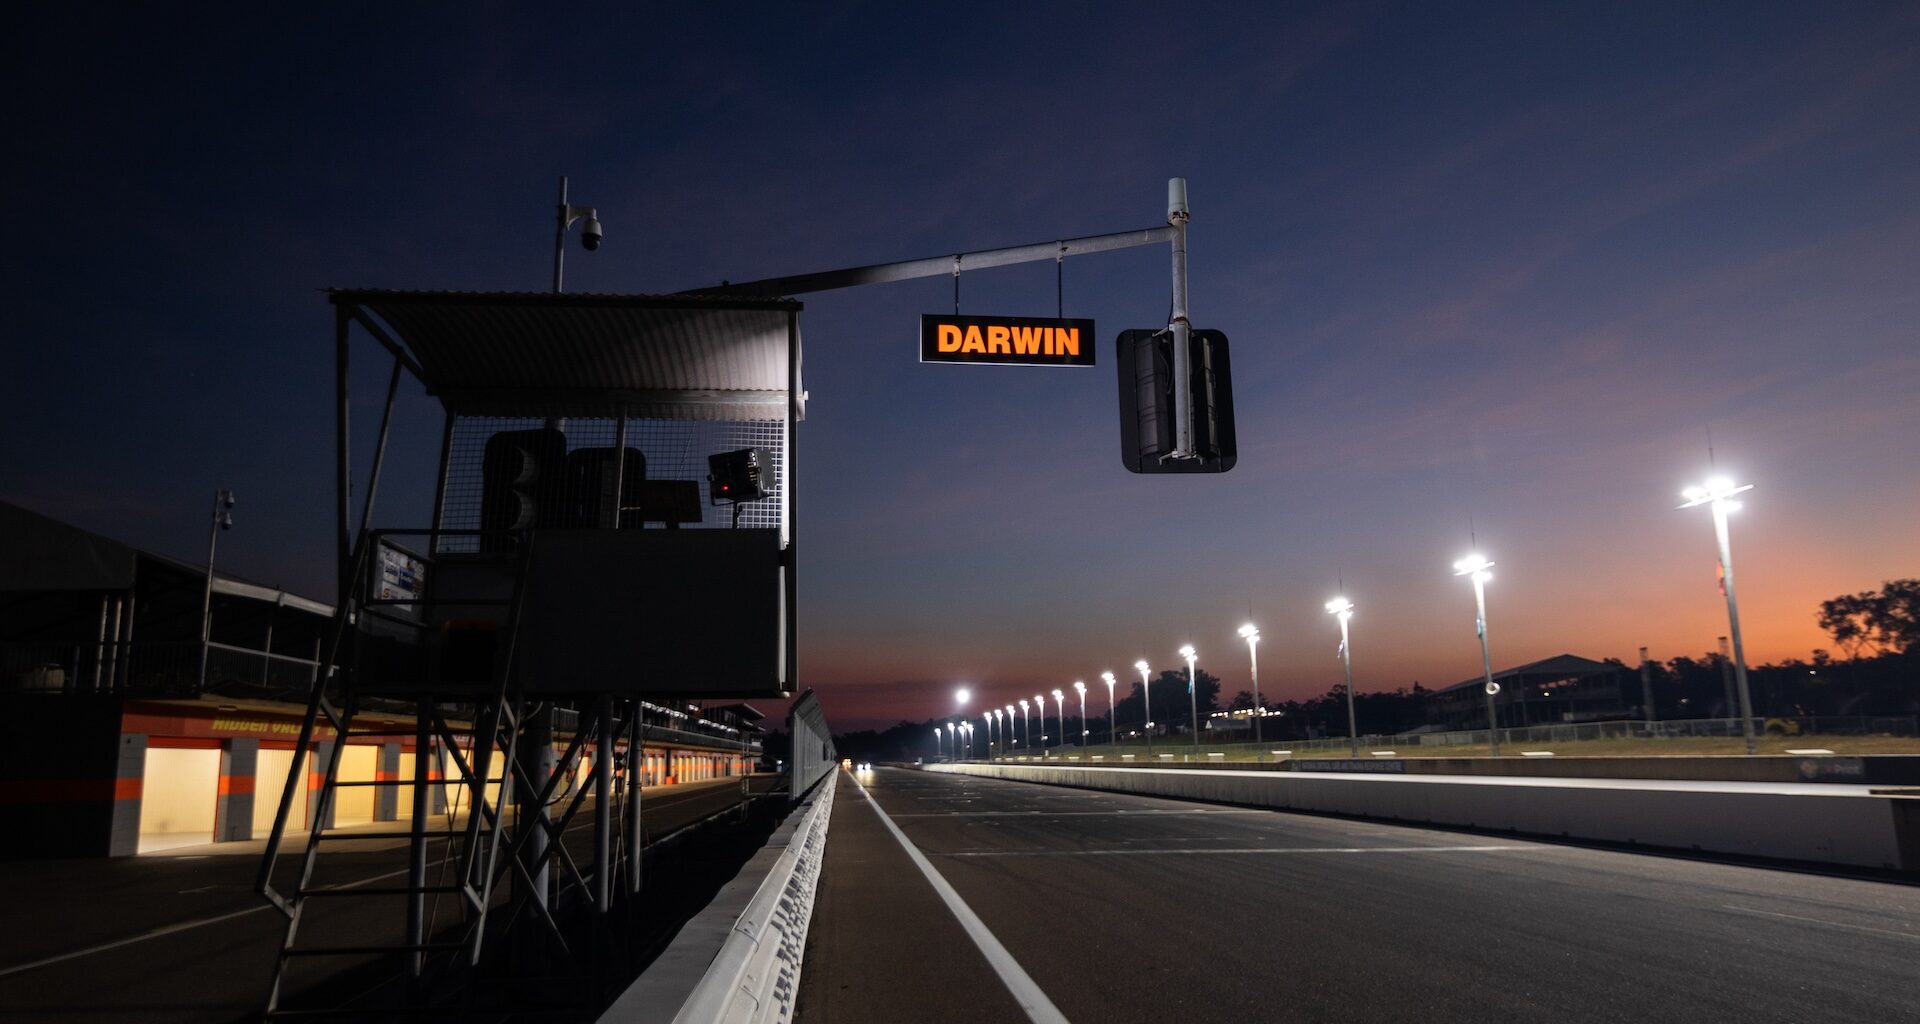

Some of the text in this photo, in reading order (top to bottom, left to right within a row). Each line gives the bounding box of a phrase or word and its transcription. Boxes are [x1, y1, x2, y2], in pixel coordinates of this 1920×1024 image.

[937, 324, 1080, 356] DARWIN
[212, 717, 269, 733] HIDDEN
[271, 720, 320, 736] VALY
